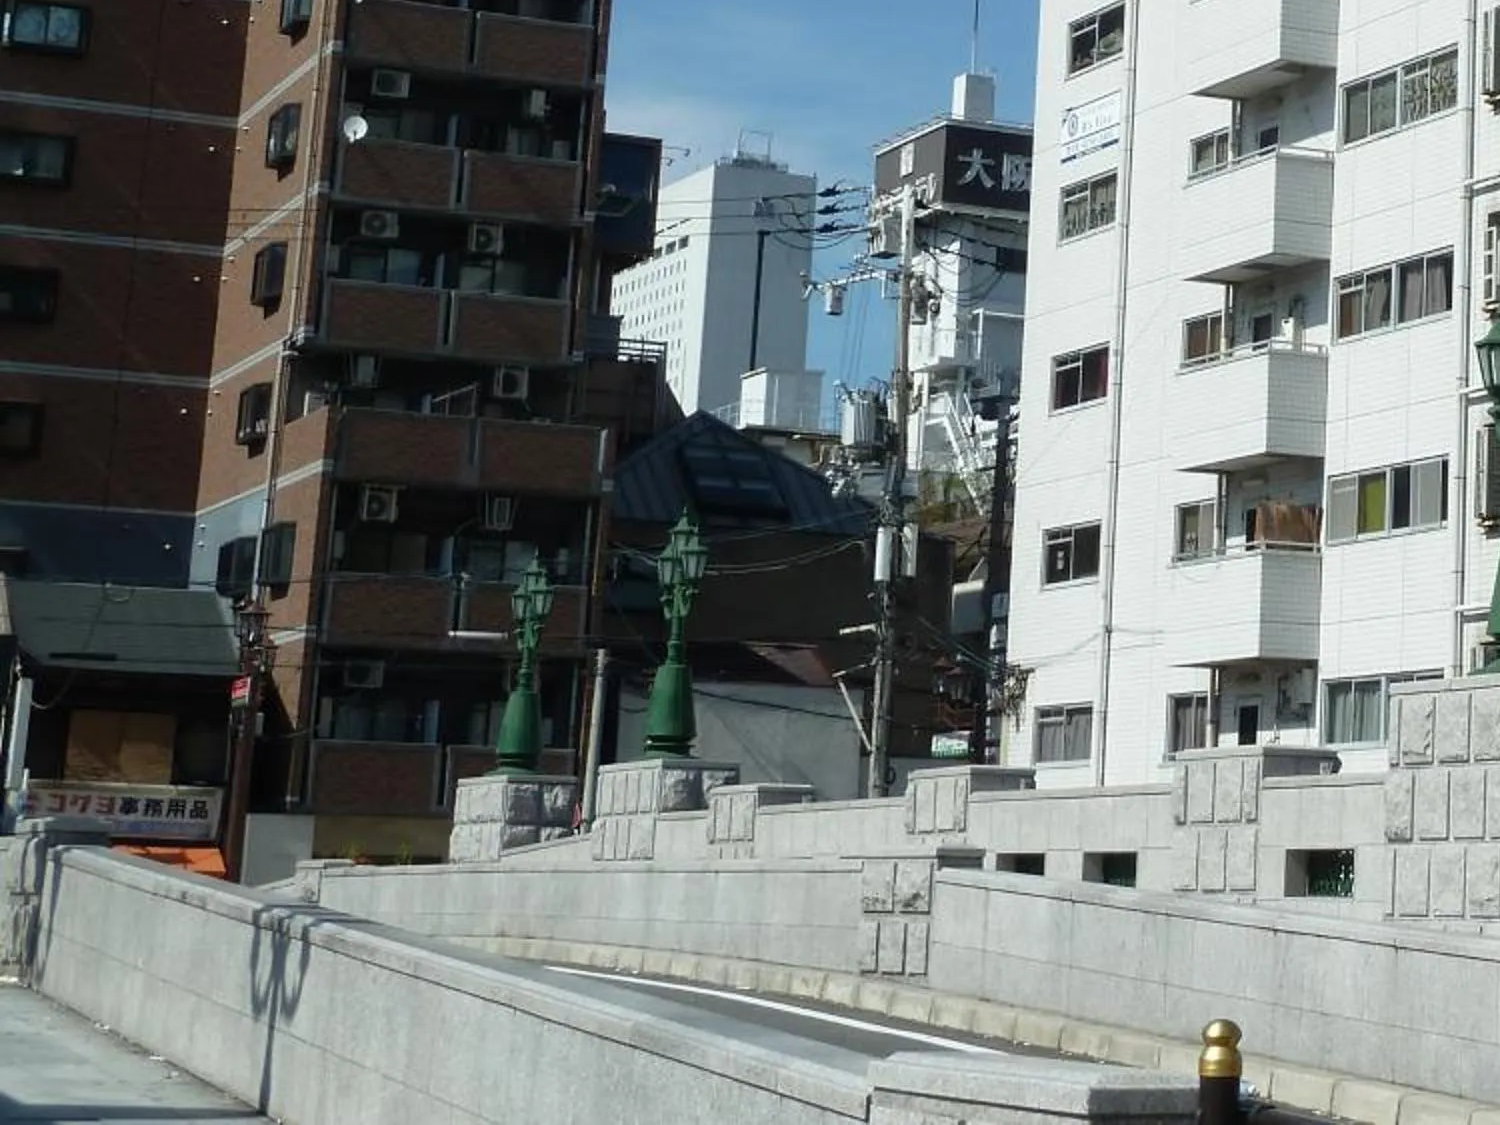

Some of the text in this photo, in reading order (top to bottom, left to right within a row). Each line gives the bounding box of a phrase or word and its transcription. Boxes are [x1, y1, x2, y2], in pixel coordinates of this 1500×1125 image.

[957, 147, 1033, 192] 大阪
[51, 792, 209, 821] コクヨ事務用品
